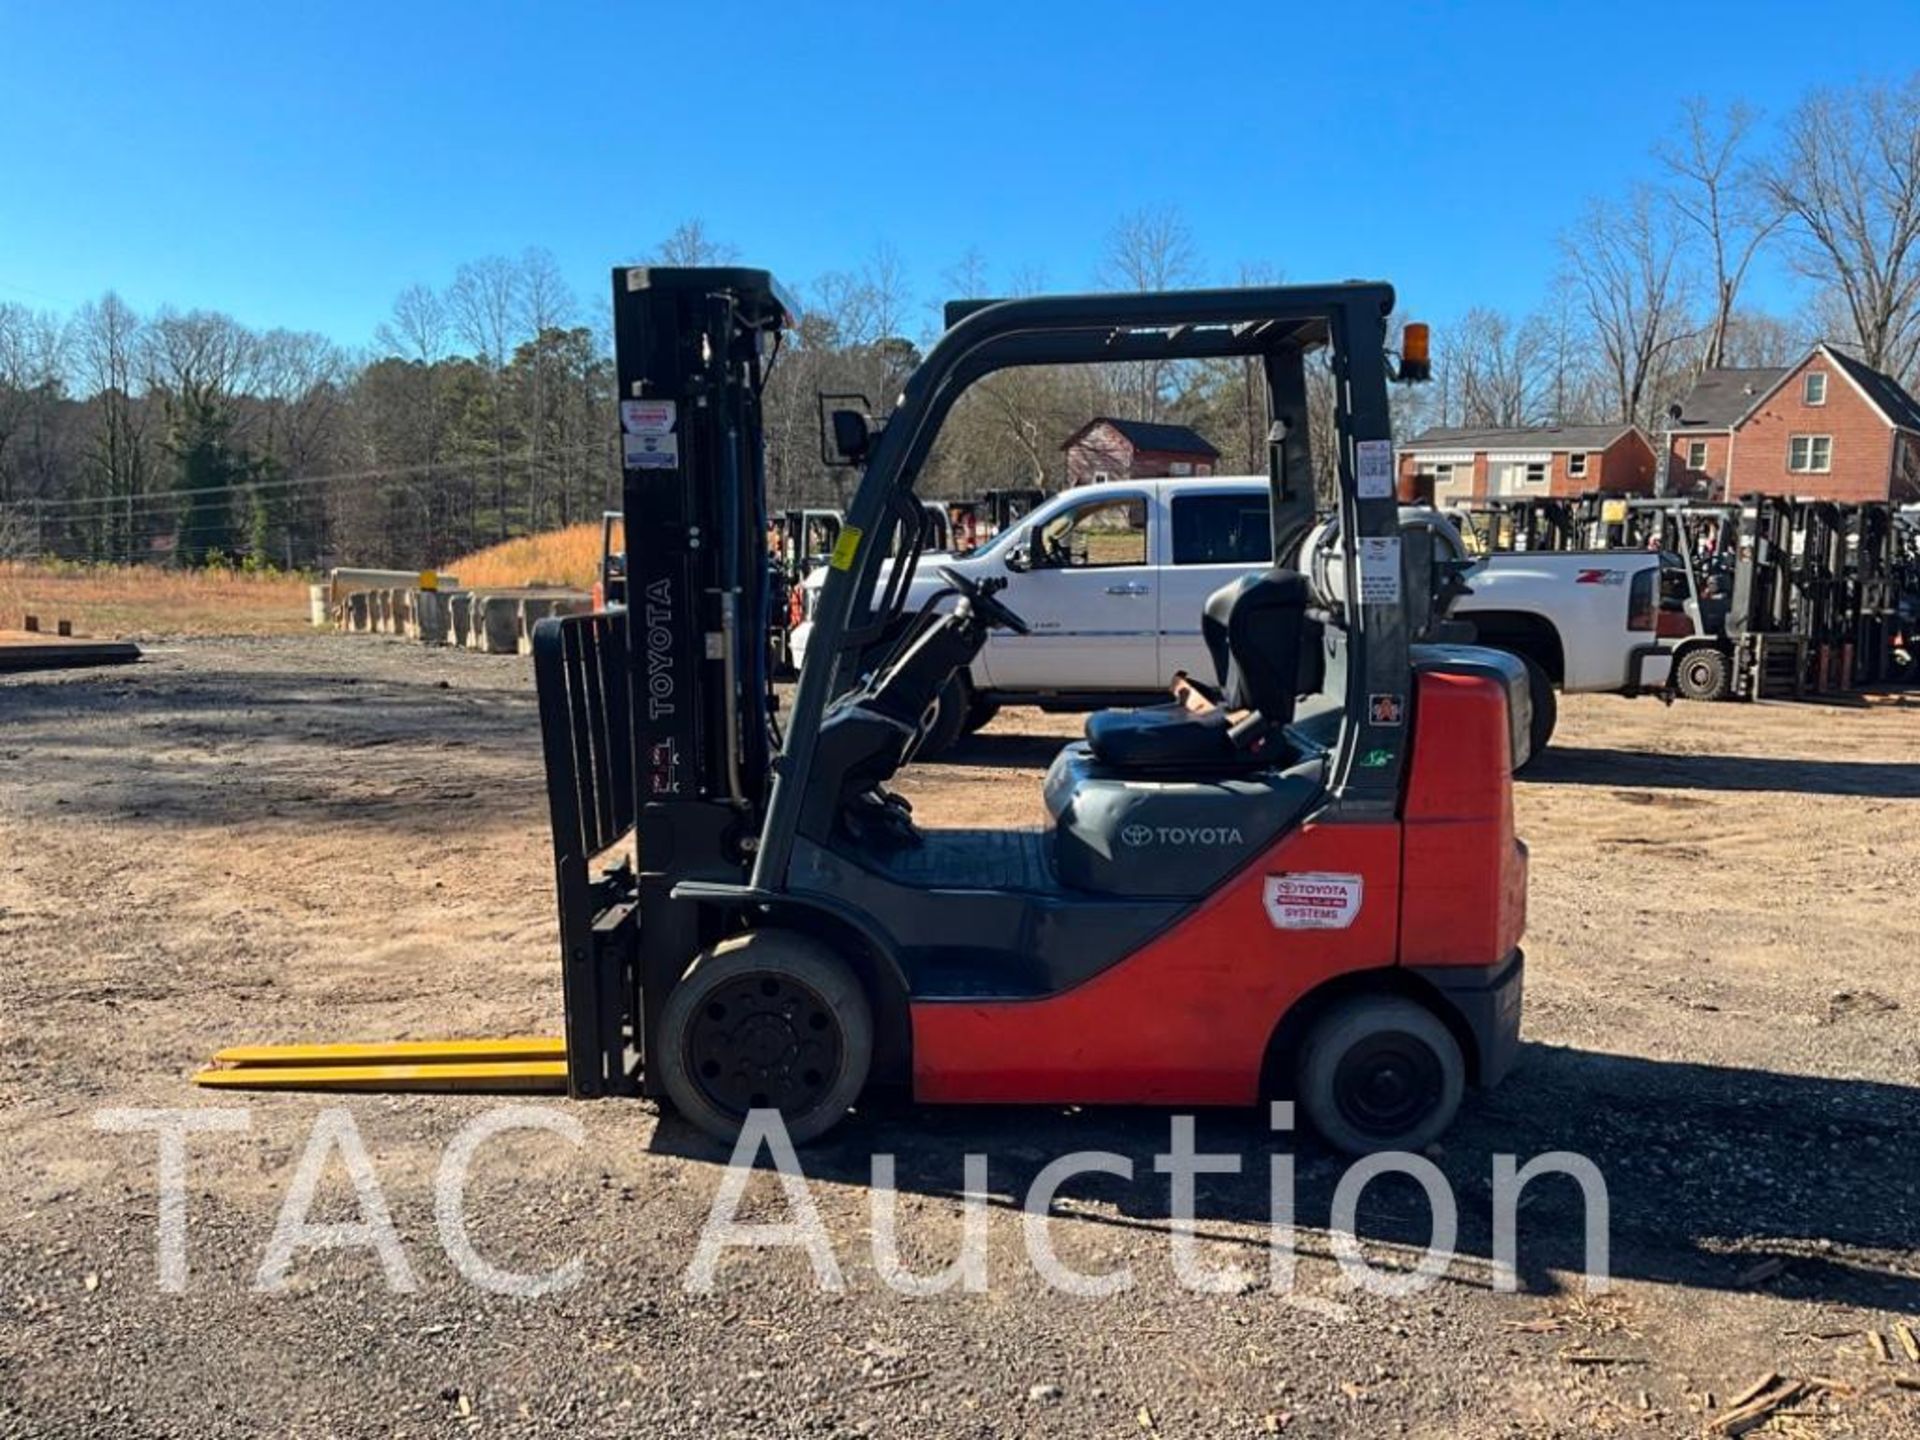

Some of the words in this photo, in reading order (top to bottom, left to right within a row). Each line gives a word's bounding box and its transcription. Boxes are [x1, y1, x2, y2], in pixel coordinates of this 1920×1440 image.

[646, 577, 675, 720] TOYOTA
[1156, 827, 1244, 845] TOYOTA
[1298, 884, 1348, 896] TOYOTA
[1285, 907, 1339, 920] SYSTEMS
